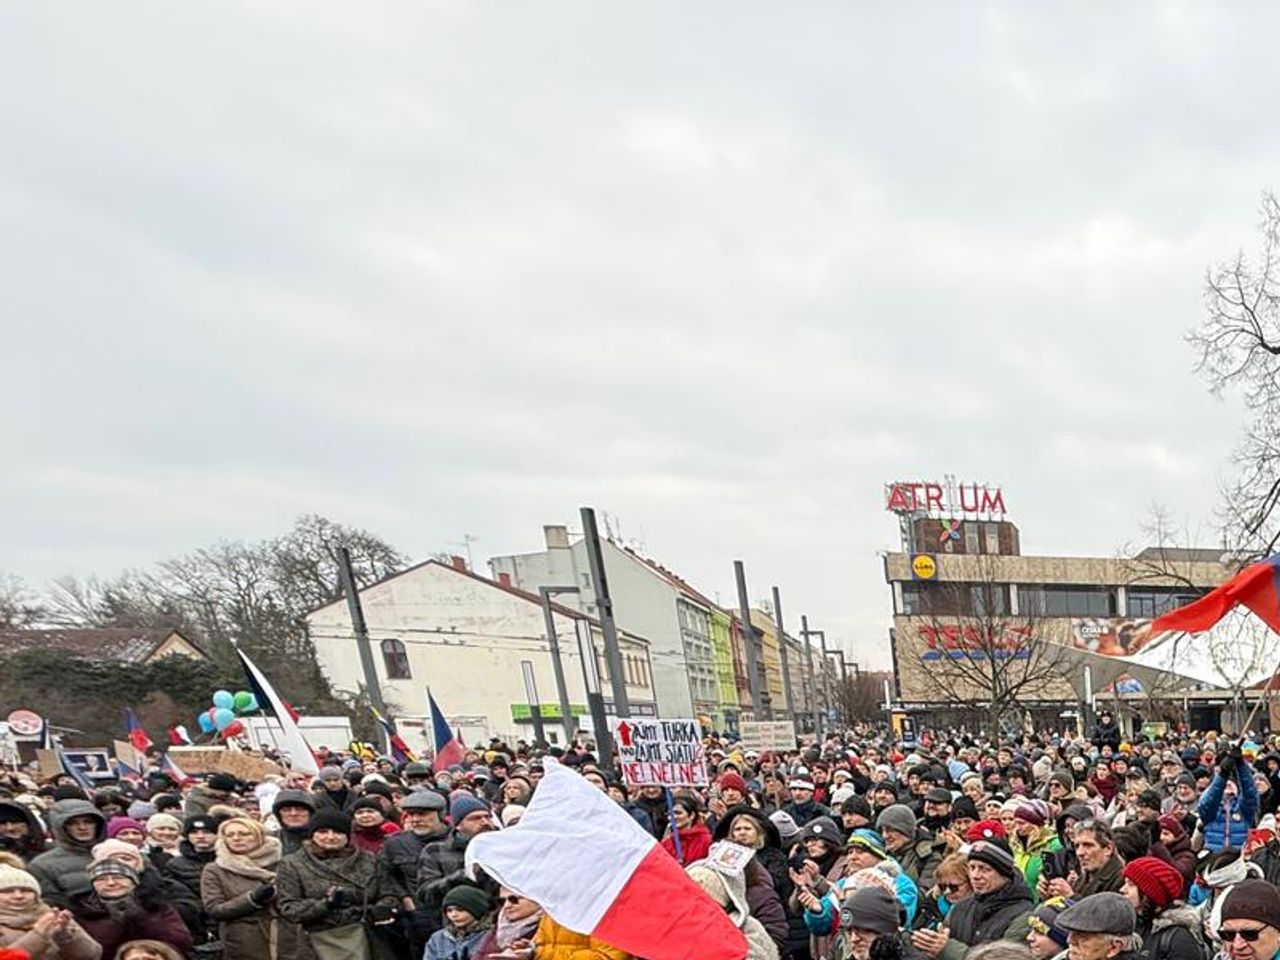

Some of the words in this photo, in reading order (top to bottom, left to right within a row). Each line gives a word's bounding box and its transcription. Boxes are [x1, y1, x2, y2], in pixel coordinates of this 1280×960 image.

[887, 483, 1006, 513] ATRUM
[660, 722, 699, 743] TURKA
[624, 762, 646, 784] NE!
[650, 762, 676, 784] NE!
[679, 762, 706, 784] NE!
